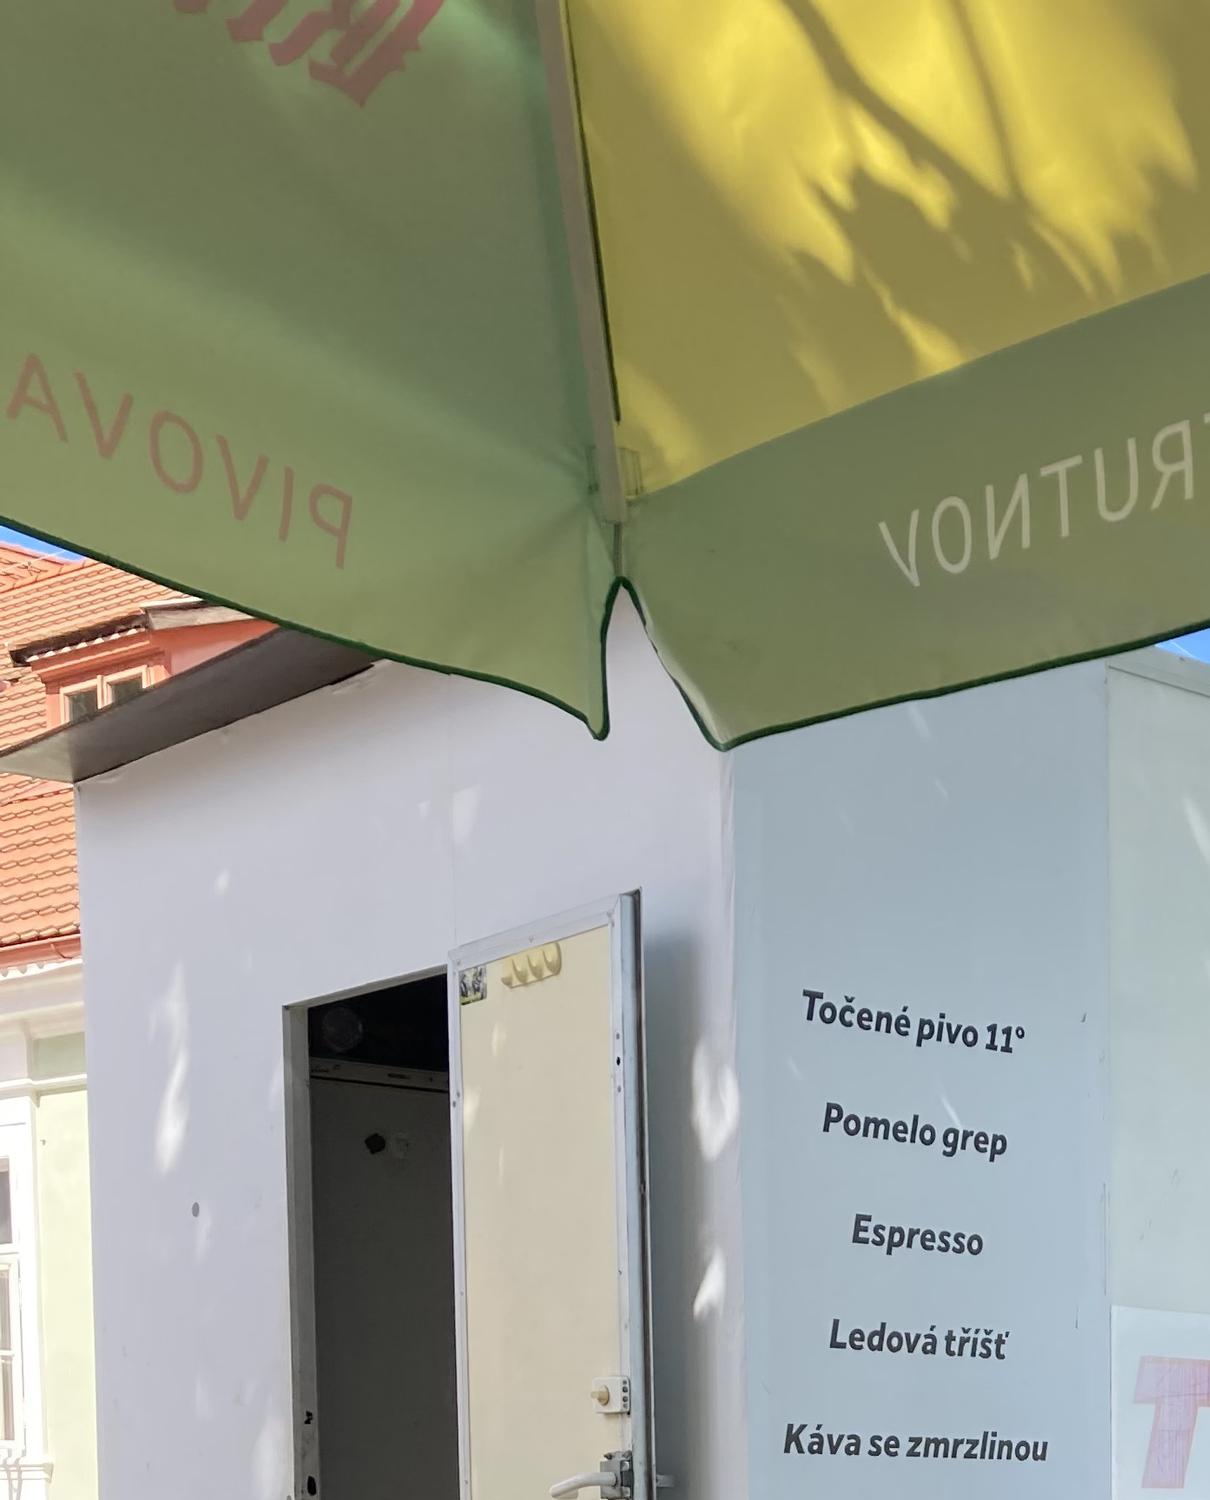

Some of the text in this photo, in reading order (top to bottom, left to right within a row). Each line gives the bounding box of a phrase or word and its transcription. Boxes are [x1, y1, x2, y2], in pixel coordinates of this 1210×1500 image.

[802, 988, 911, 1037] Točené
[915, 1012, 979, 1048] pivo
[822, 1101, 1008, 1163] Pomelo grep
[851, 1213, 984, 1256] Espresso
[829, 1318, 1010, 1360] Ledová tříšť
[783, 1423, 1049, 1461] Káva se zmrzlinou
